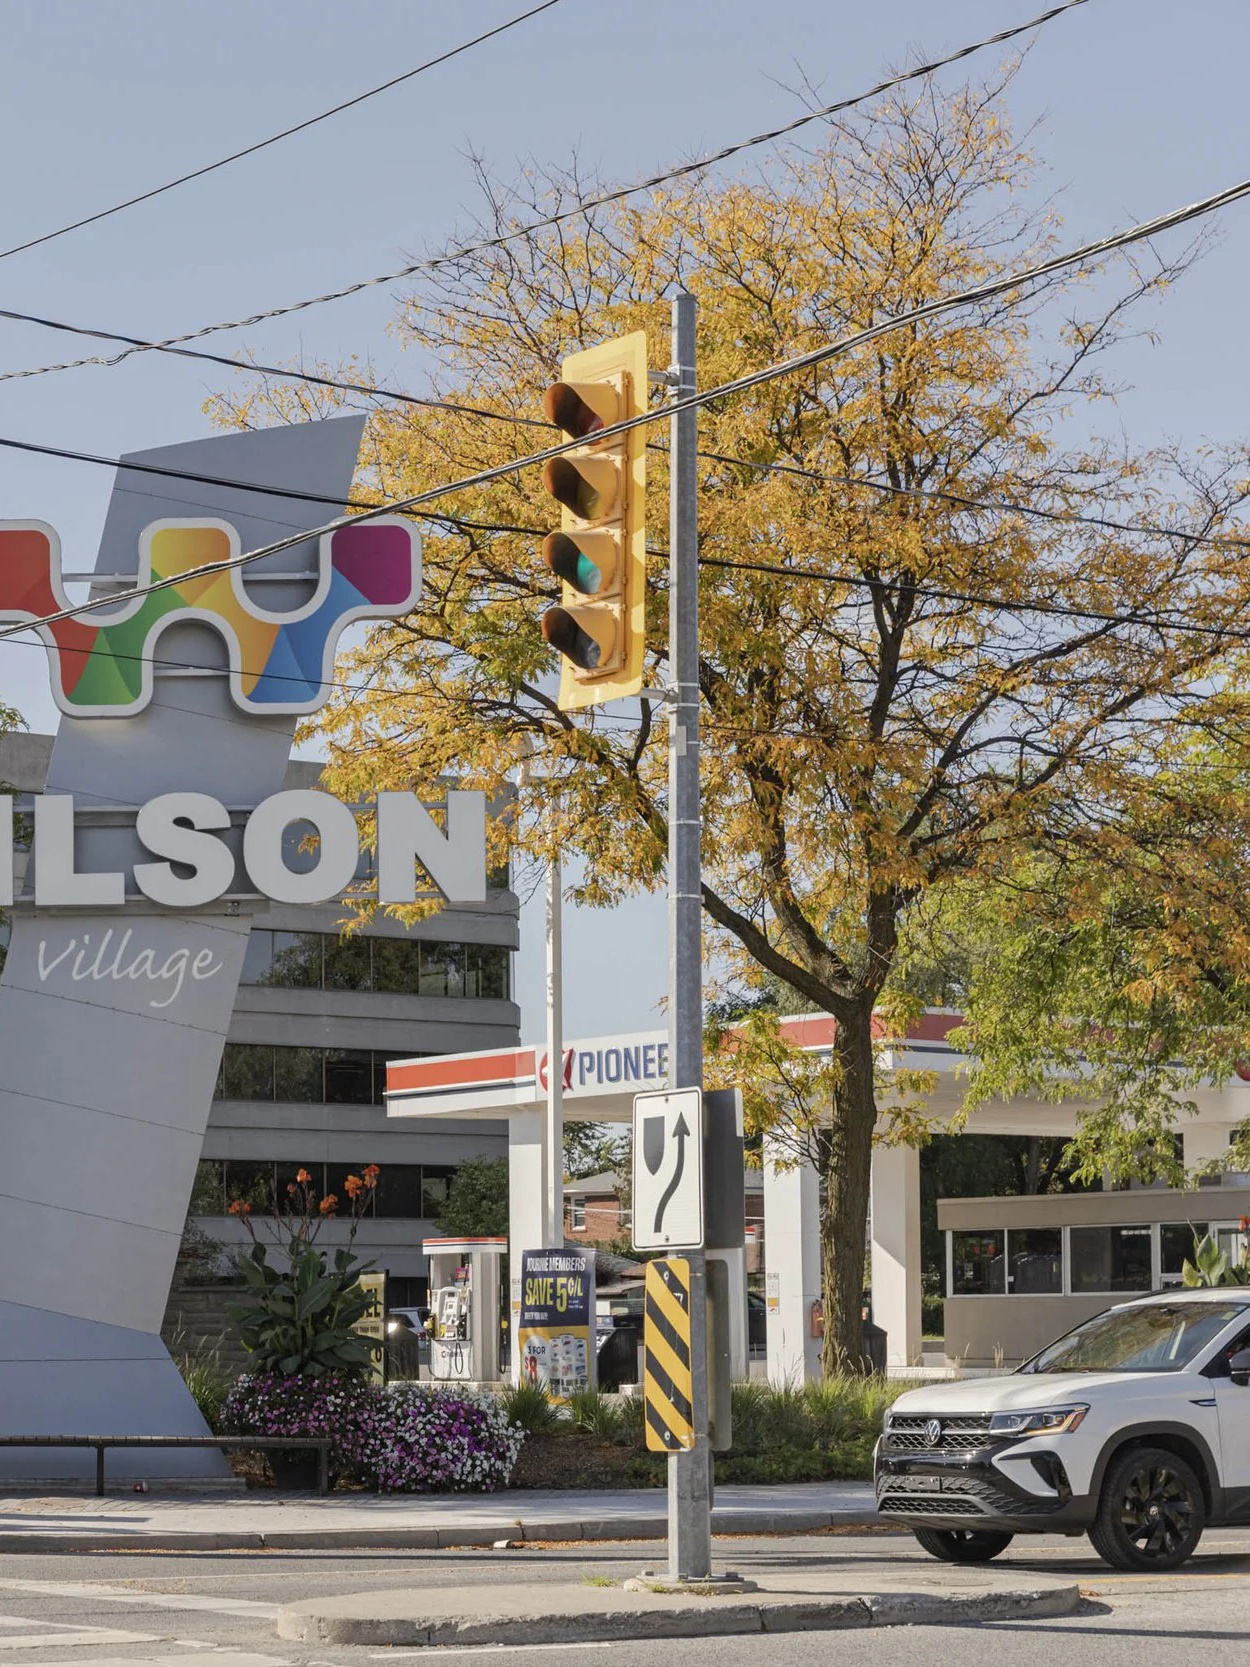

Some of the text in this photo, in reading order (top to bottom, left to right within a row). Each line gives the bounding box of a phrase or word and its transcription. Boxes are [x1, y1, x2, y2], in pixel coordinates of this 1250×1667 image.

[38, 928, 223, 1008] Village
[578, 1042, 669, 1086] PIONEE
[549, 1256, 586, 1272] MEMBERS
[525, 1277, 554, 1306] SAVE
[527, 1345, 546, 1355] 3 FOR
